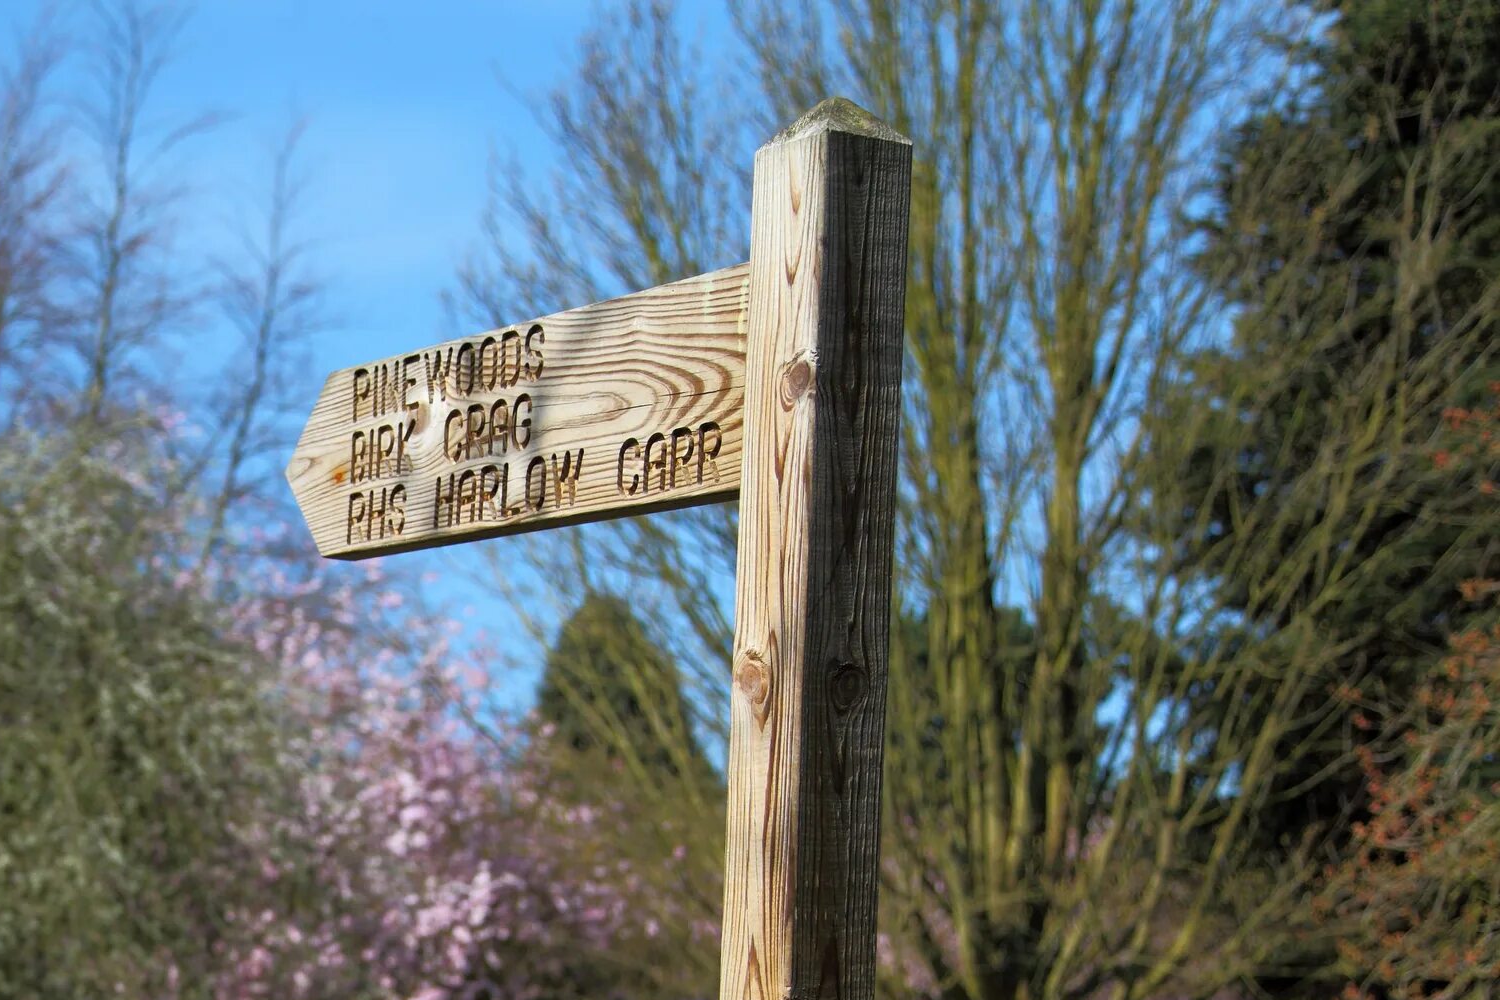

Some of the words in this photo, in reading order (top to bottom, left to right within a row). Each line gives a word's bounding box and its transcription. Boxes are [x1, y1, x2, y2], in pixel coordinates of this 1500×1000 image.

[353, 324, 546, 423] PINEWOODS
[347, 485, 406, 545] RHS
[435, 448, 585, 528] HARLOW
[618, 421, 723, 496] CARR
[350, 419, 416, 484] BIRK
[443, 393, 532, 464] CRAG
